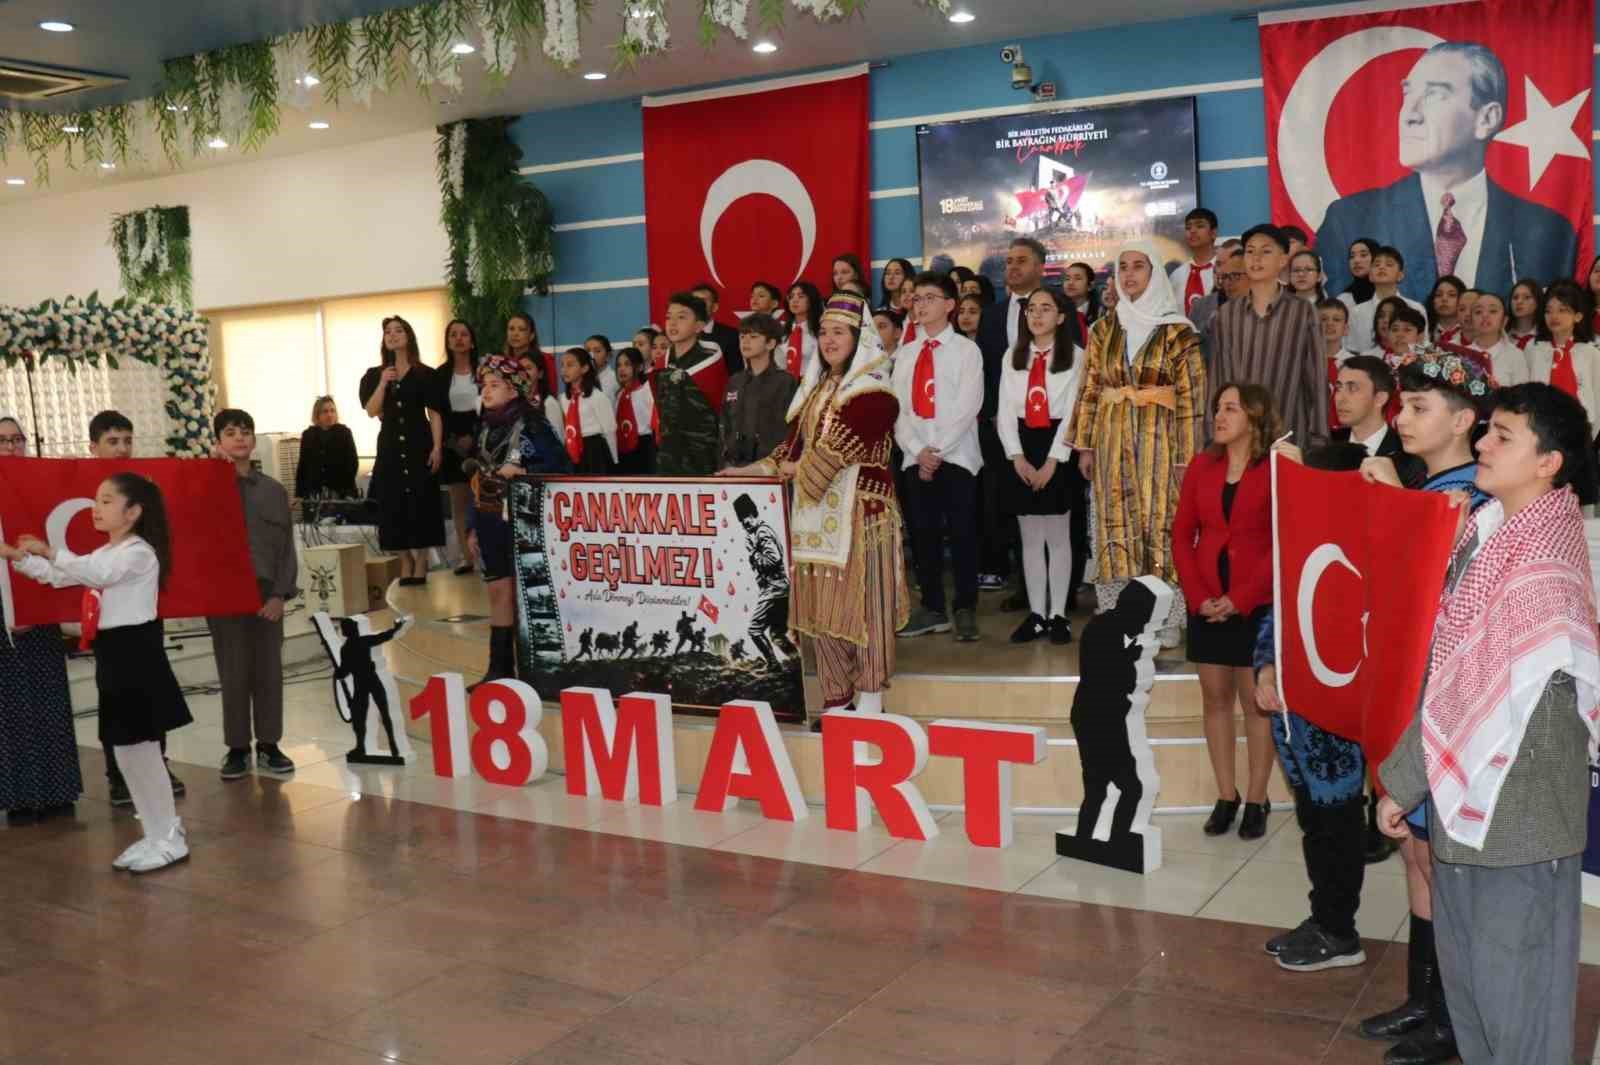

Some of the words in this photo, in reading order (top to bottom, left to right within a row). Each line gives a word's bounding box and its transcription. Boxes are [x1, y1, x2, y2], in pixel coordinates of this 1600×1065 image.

[995, 138, 1011, 149] BİR
[1012, 135, 1056, 148] BAYRAĞIN
[1056, 129, 1107, 142] HÜRRİYETİ
[939, 198, 953, 214] 18
[553, 491, 717, 542] ÇANAKKALE
[568, 537, 715, 591] GEÇİLMEZ!
[409, 673, 546, 787] 18
[560, 687, 1046, 848] MART
